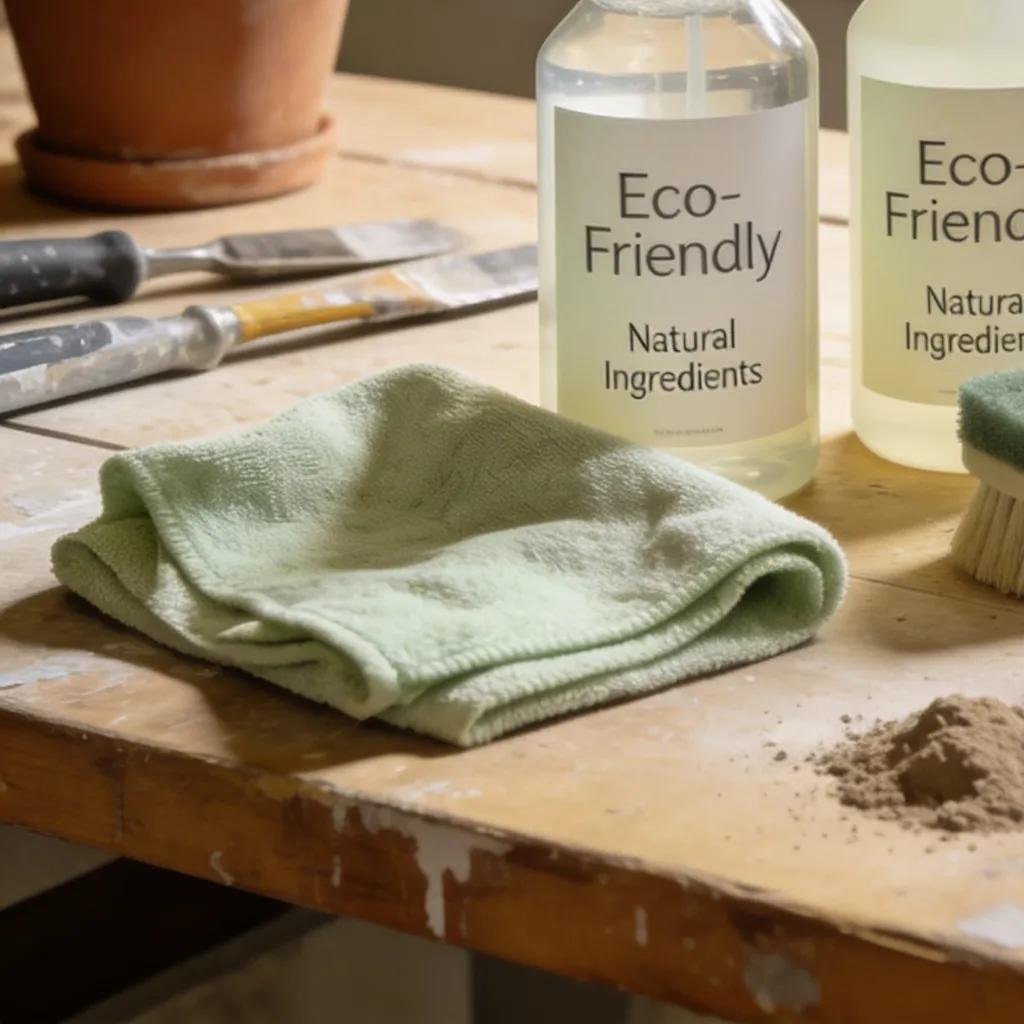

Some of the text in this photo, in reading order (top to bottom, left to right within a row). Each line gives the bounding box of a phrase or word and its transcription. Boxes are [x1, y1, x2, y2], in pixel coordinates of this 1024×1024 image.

[618, 171, 742, 220] Eco-
[584, 220, 783, 284] Friendly
[628, 317, 736, 354] Natural
[604, 359, 763, 401] Ingredients
